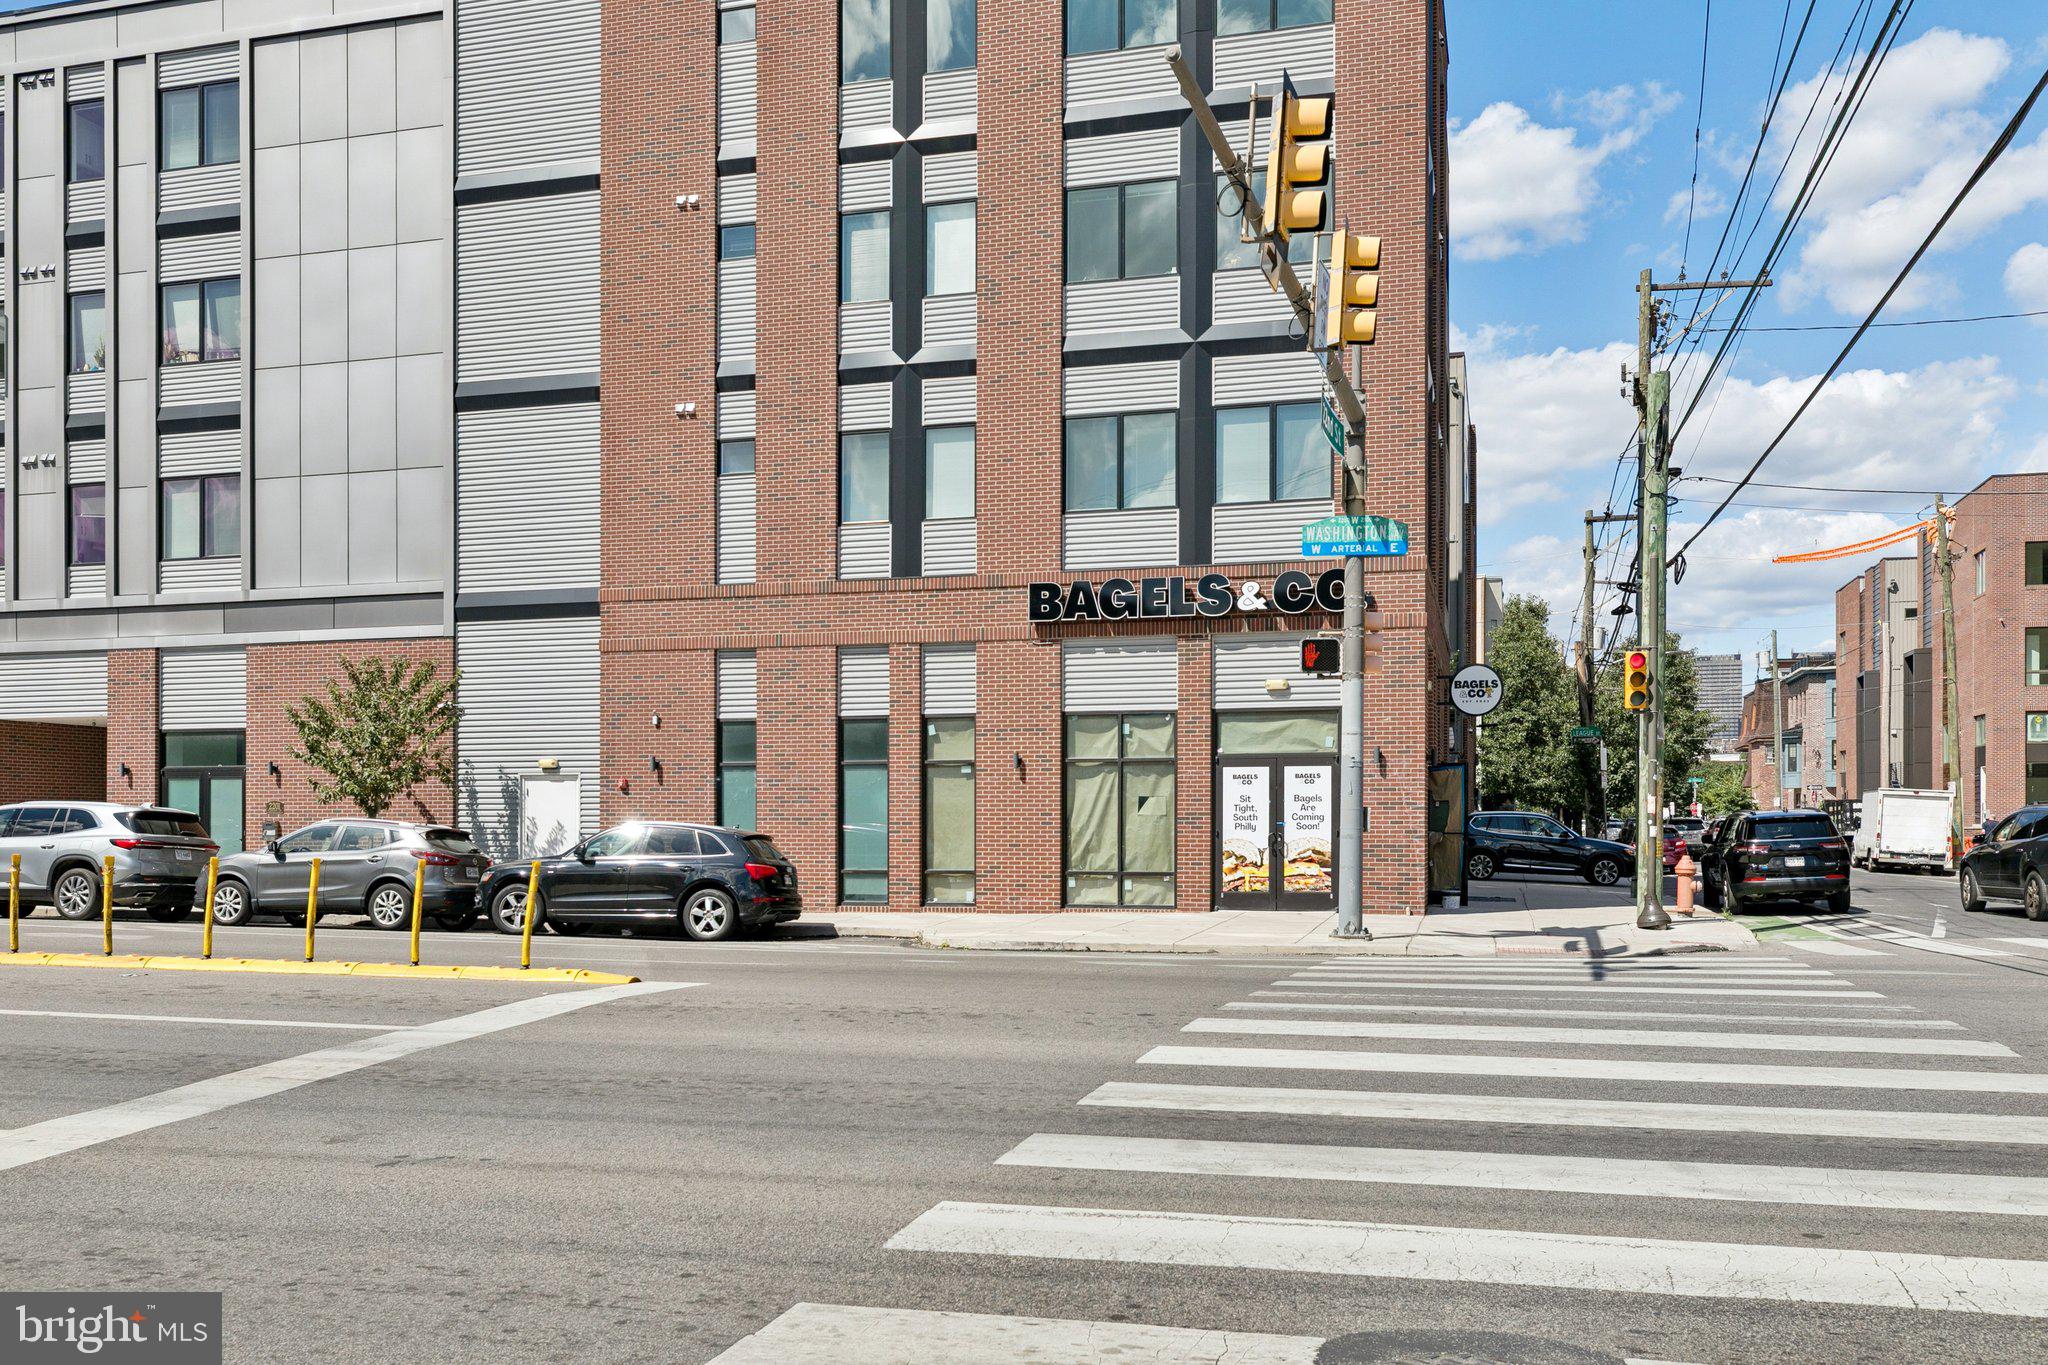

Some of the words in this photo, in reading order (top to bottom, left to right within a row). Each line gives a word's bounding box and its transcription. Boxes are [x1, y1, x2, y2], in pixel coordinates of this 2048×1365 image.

[1306, 525, 1387, 542] WASHINGTON
[1311, 544, 1321, 554] W
[1330, 544, 1378, 553] ARTERIAL
[1390, 542, 1399, 552] E
[1028, 573, 1234, 622] BAGELS
[1454, 680, 1499, 689] BAGELS
[1240, 795, 1251, 803] Sit
[1293, 795, 1323, 804] Bagels
[1300, 804, 1316, 812] Are
[1233, 814, 1258, 822] South
[1291, 813, 1325, 823] Coming
[1234, 823, 1257, 832] Philly
[1296, 822, 1320, 830] Soon!
